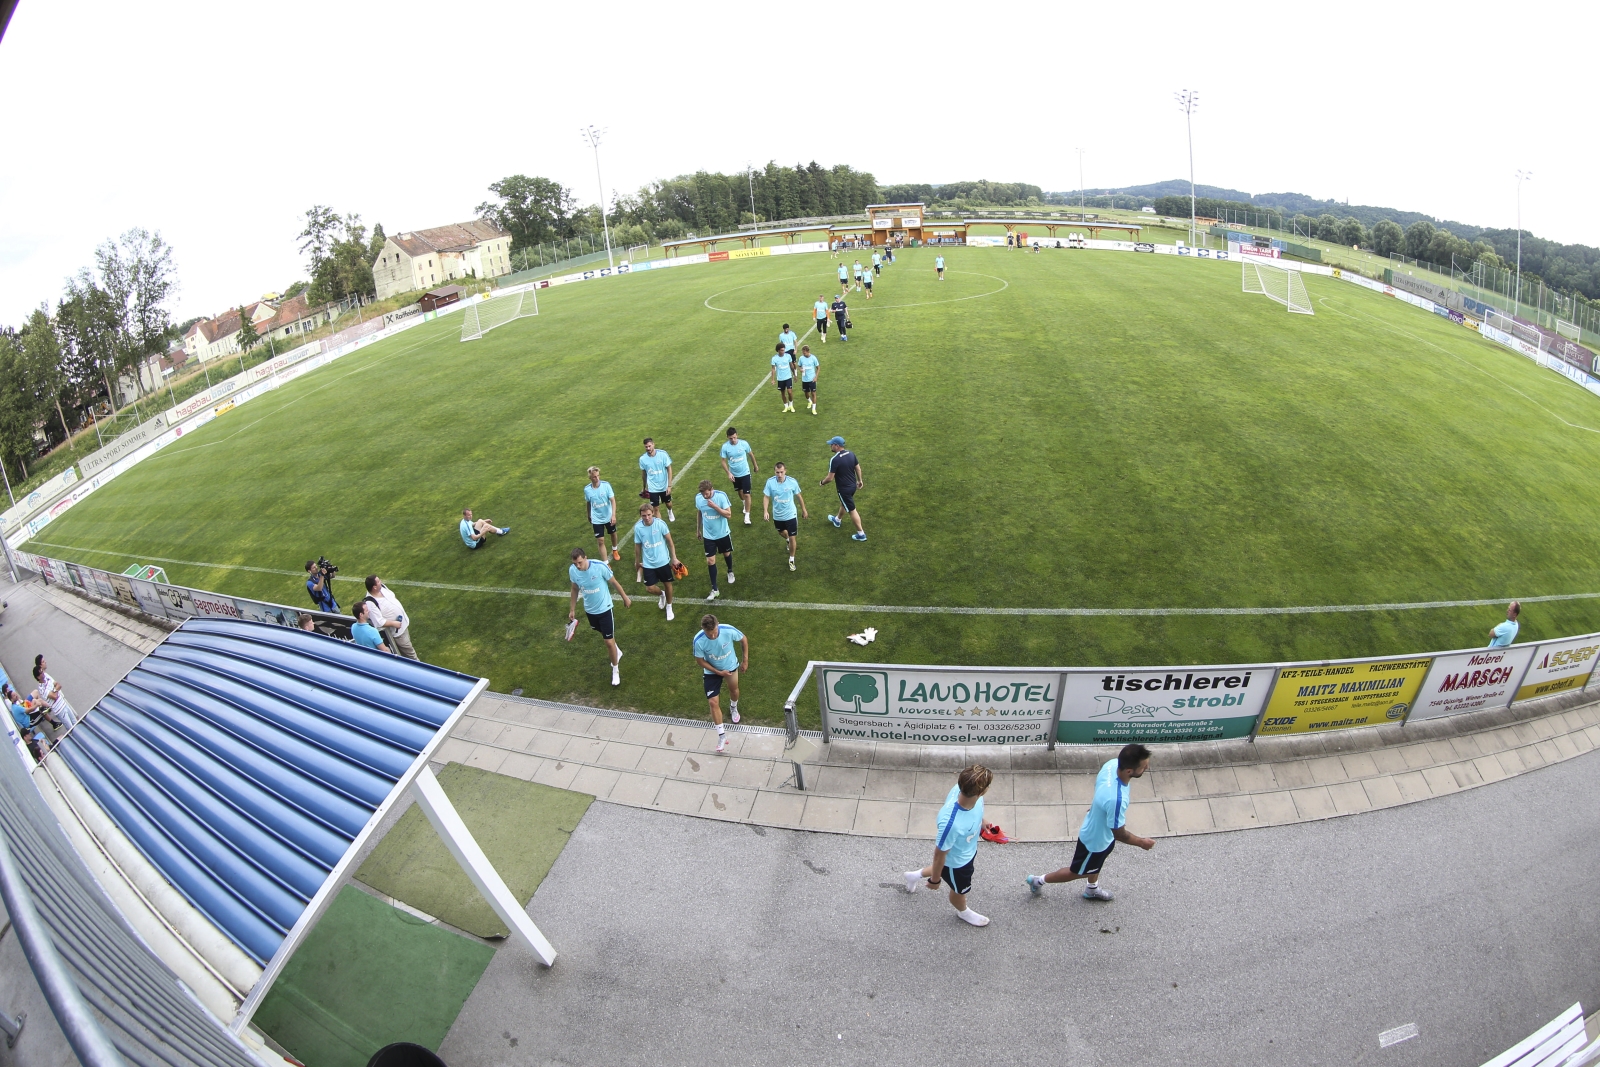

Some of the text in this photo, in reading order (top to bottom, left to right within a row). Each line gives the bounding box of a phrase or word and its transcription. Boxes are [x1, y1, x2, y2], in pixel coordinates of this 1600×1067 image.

[395, 308, 420, 320] Raiffeisen
[176, 393, 212, 419] hagebau
[83, 430, 147, 472] ULTRA SPORT SOMMER
[1467, 651, 1506, 667] Malerei
[1549, 645, 1600, 668] SCHERF
[1281, 666, 1355, 679] KFZ-TEILE-HANDEL
[1369, 660, 1430, 673] FACHWERKSTÄTTE
[1101, 672, 1252, 692] tischlerei
[1437, 665, 1514, 694] MARSCH
[1534, 678, 1575, 694] www.scherf.at
[1297, 677, 1406, 697] MAITZ MAXIMILIAN
[1172, 693, 1245, 709] strobl
[1310, 696, 1349, 706] STEGERSBACH
[1352, 691, 1392, 701] HAUPTSTRASSE
[1483, 691, 1498, 699] Straße
[898, 706, 952, 715] NOVOSEL
[1088, 695, 1184, 721] Design
[838, 717, 893, 728] Stegersbach
[903, 720, 947, 731] Ägidiplatz
[983, 723, 1041, 731] 03326/52300
[1168, 720, 1208, 728] Angerstraße
[1264, 716, 1298, 726] EXIDE
[1308, 716, 1369, 730] www.maitz.net
[831, 725, 1049, 745] www.hotel-novosel-wagner.at
[1261, 725, 1292, 733] Batterien
[1092, 732, 1223, 743] www.tischlerei-strobl-design.at
